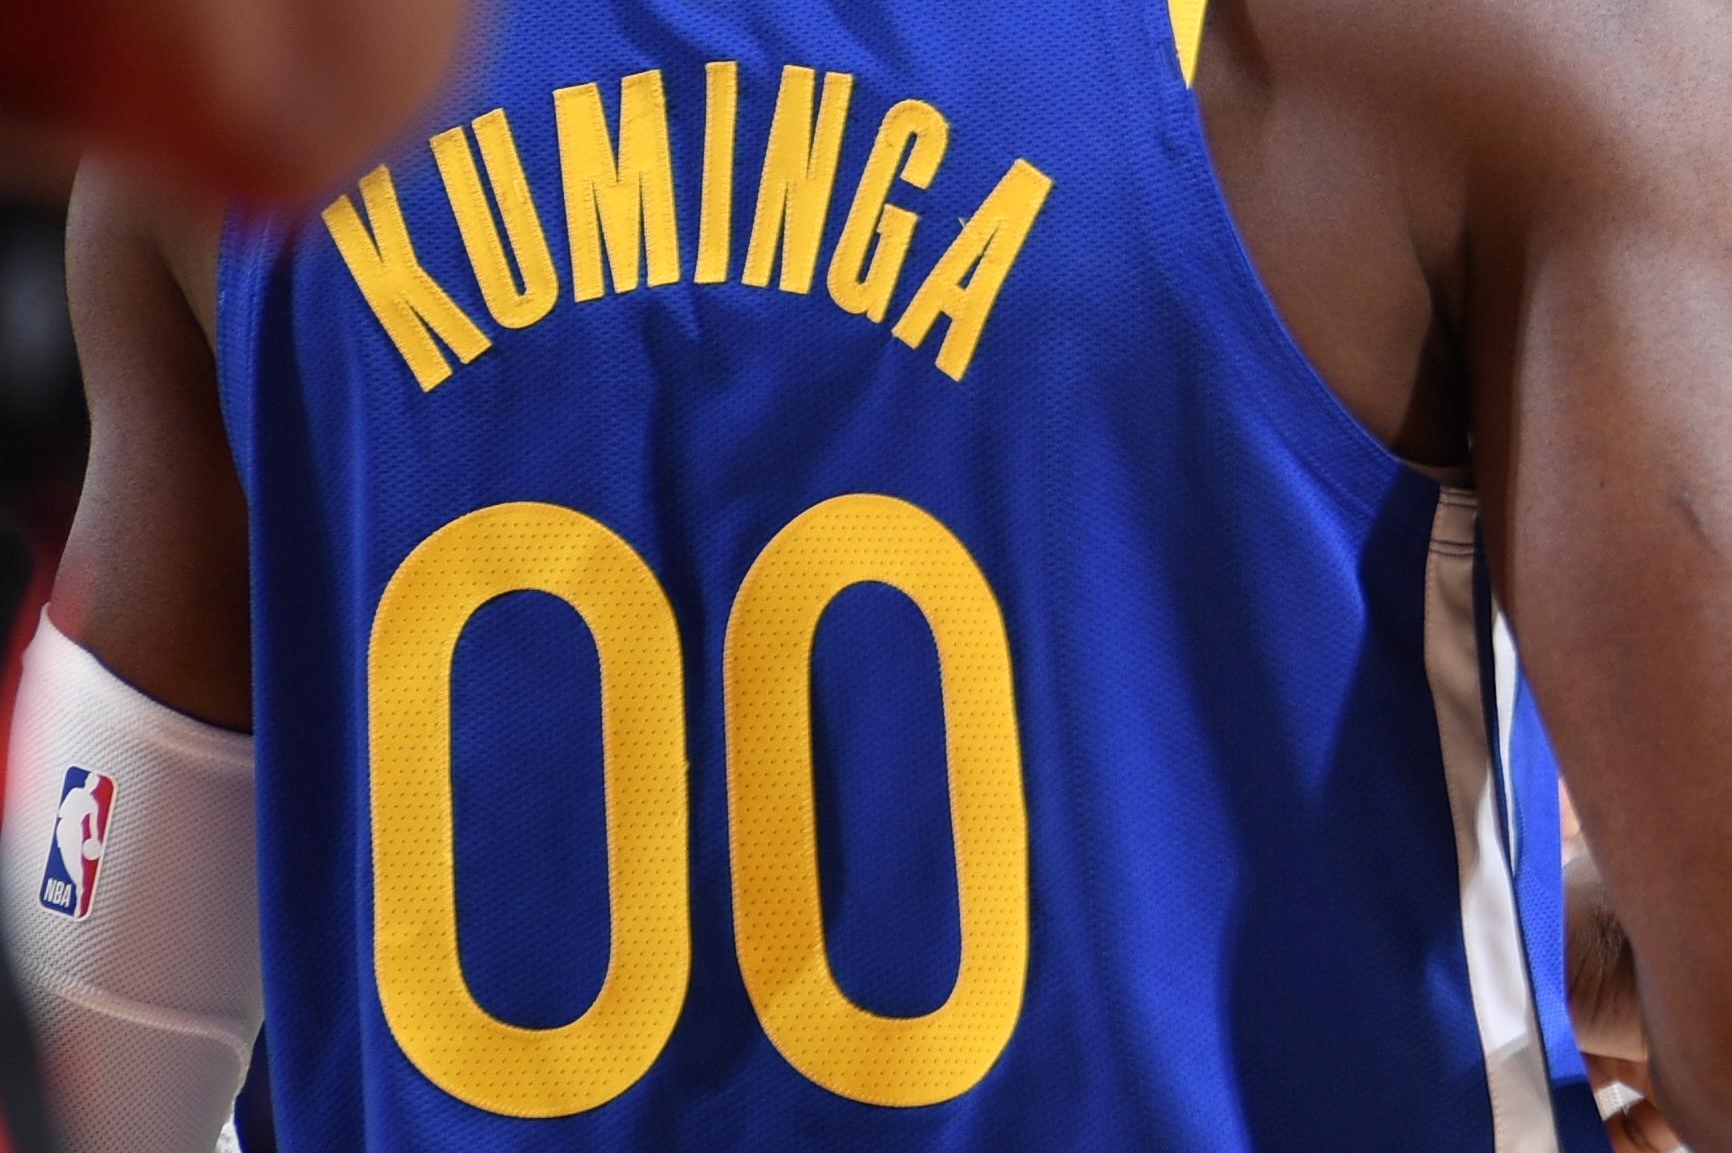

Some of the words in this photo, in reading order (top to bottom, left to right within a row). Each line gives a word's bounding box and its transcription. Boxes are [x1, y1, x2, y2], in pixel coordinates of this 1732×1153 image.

[321, 60, 1055, 393] KUMINGA
[43, 877, 72, 908] NBA
[367, 492, 1030, 1120] 00
